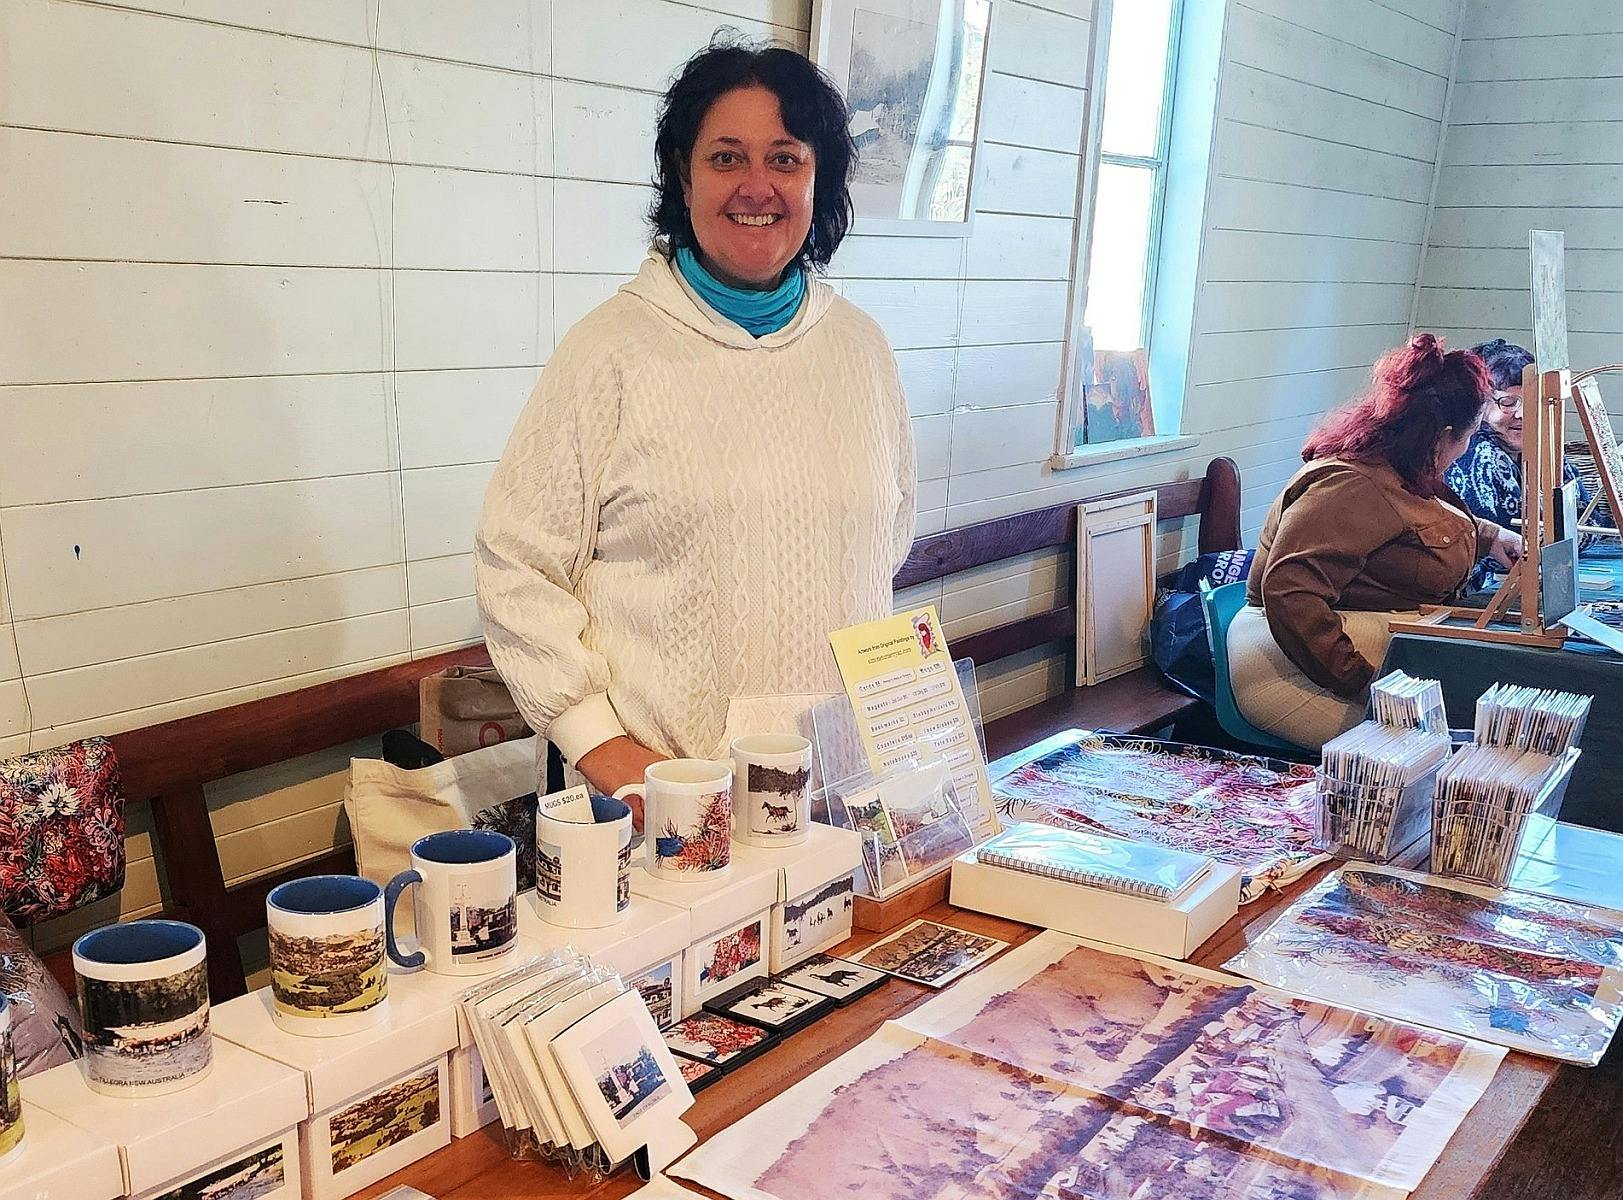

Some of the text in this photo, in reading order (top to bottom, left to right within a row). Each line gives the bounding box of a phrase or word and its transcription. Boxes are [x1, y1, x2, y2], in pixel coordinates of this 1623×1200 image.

[1212, 550, 1232, 584] RRO
[544, 799, 562, 810] MUGS
[147, 1072, 185, 1085] AUSTRALIA
